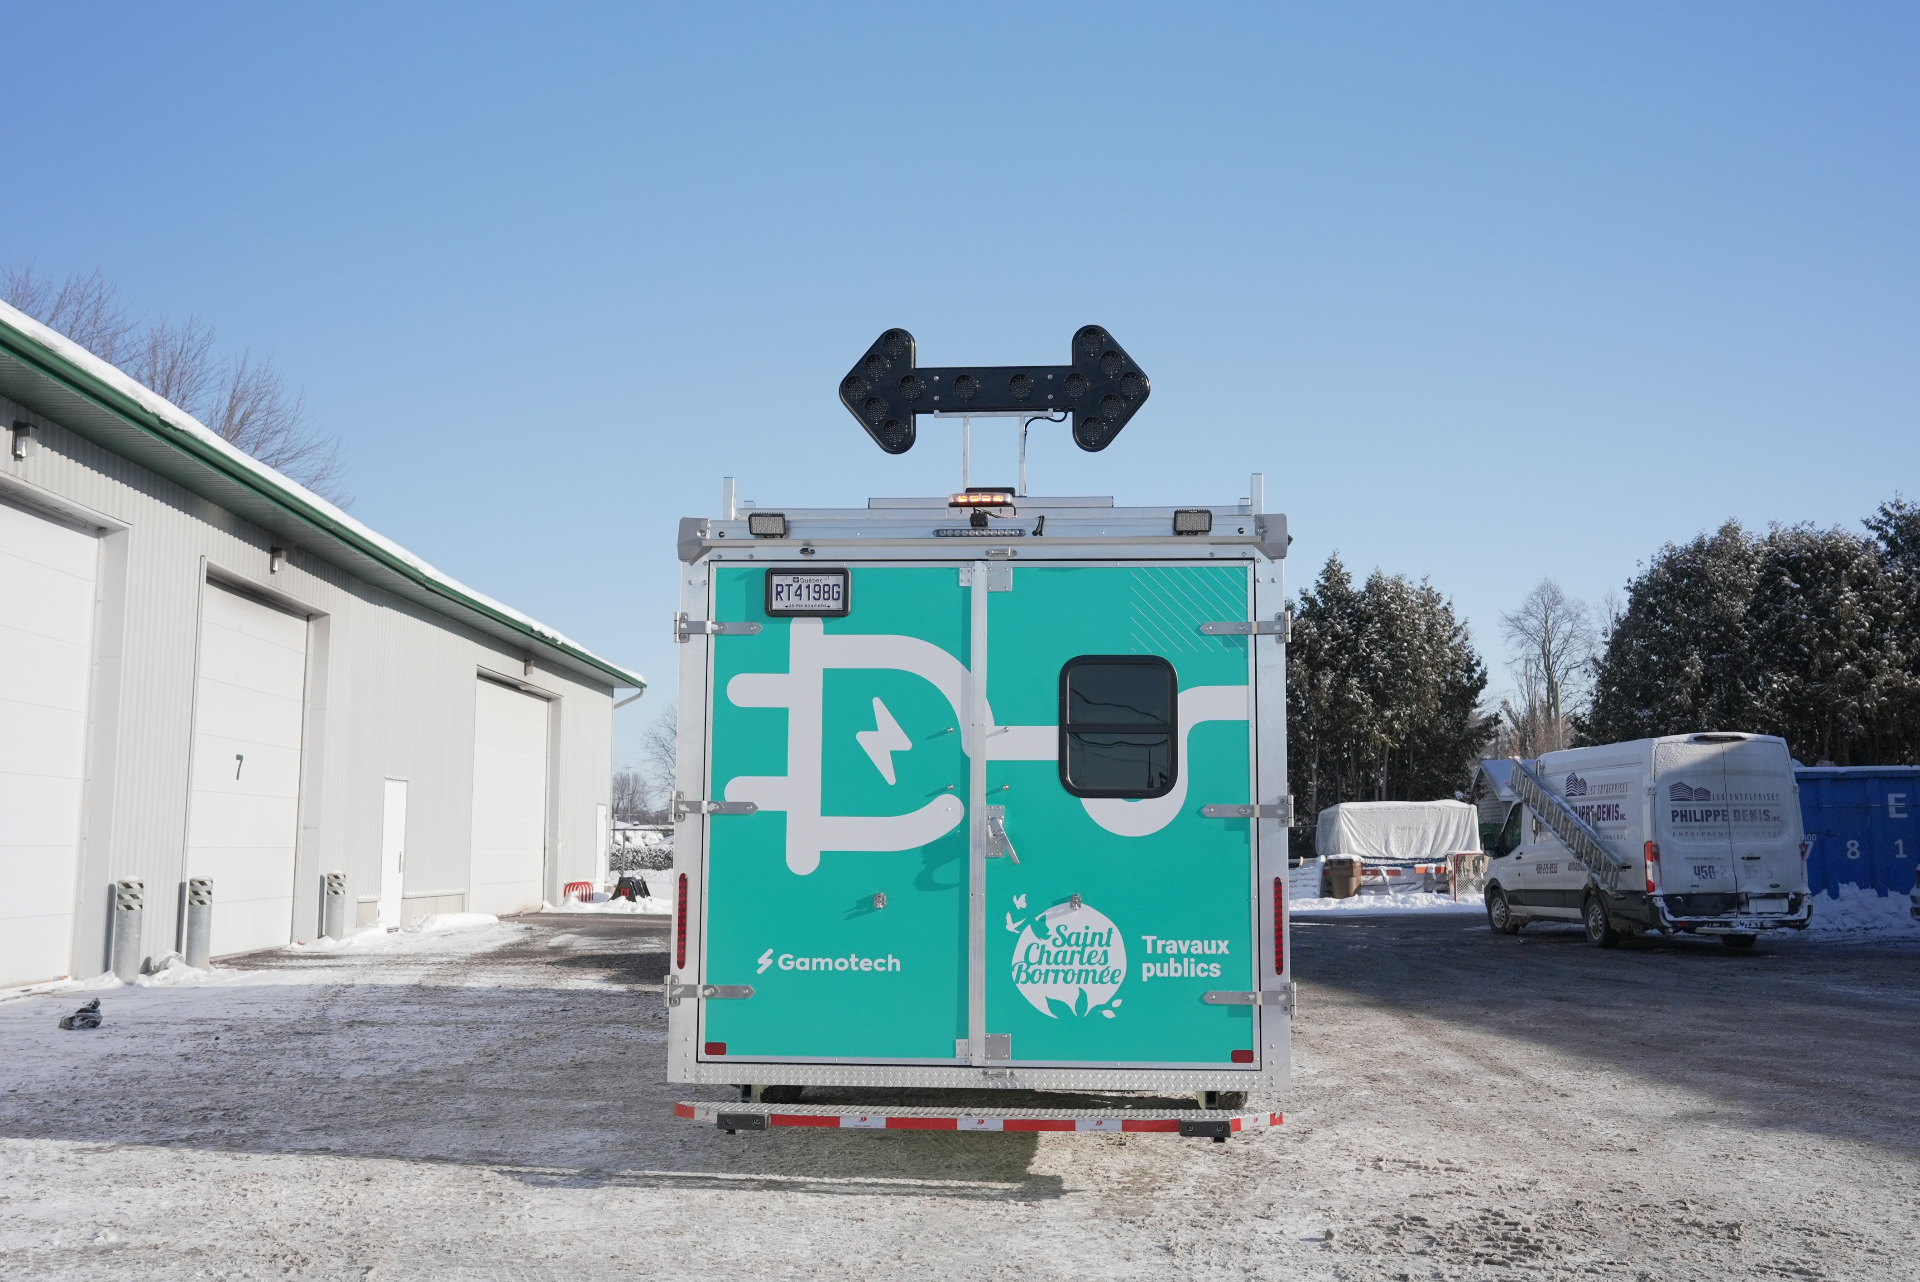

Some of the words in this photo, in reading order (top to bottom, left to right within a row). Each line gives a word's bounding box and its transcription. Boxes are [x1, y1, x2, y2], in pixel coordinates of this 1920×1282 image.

[775, 584, 841, 601] RT4198G
[236, 754, 243, 780] 7
[1712, 793, 1725, 801] LES
[1730, 793, 1780, 801] ENTREPRISES
[1887, 793, 1908, 818] E
[1597, 803, 1620, 821] DENIS
[1671, 809, 1728, 822] PHILIPPE
[1733, 809, 1770, 822] DENIS
[1846, 839, 1861, 859] 8
[1894, 839, 1908, 858] 1
[1051, 924, 1114, 948] Saint
[1141, 935, 1230, 954] Travaux
[777, 953, 901, 972] Gamotech
[1023, 942, 1109, 966] Charles
[1011, 960, 1122, 985] Borromée
[1142, 957, 1222, 982] publics
